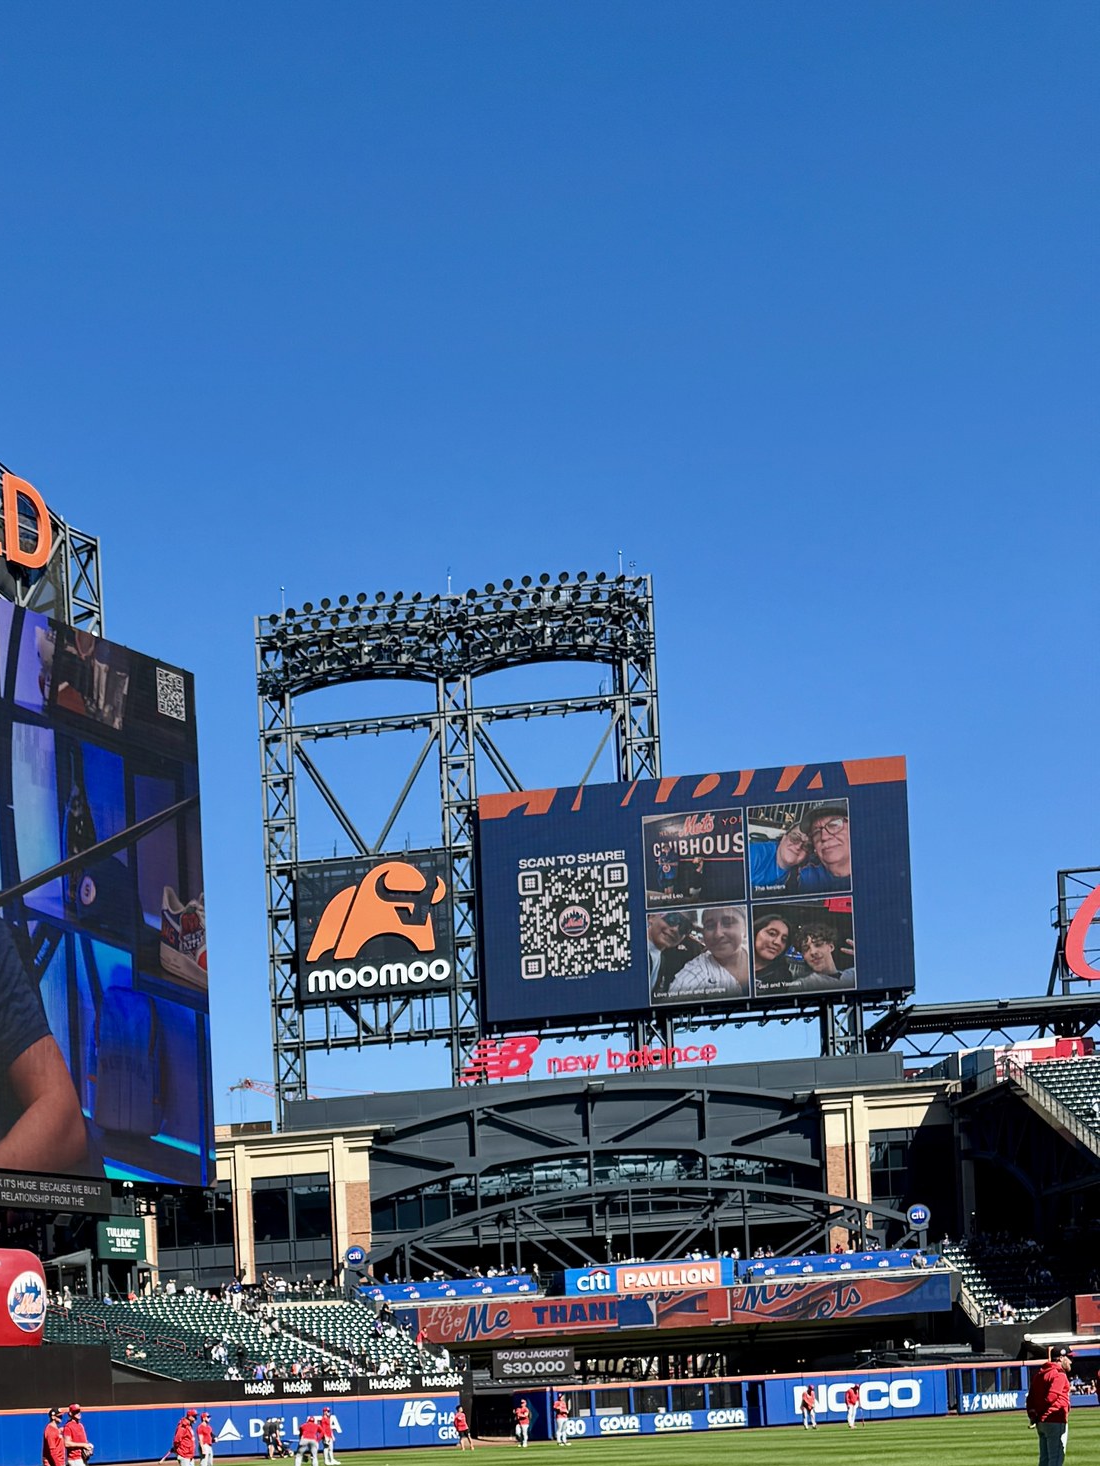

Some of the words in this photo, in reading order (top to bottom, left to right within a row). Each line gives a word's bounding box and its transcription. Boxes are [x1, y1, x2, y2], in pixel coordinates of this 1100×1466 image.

[678, 813, 715, 837] Mets
[653, 832, 744, 857] CUBHOUS
[518, 856, 555, 869] SCAN
[557, 855, 575, 866] TO
[577, 850, 625, 863] SHARE!
[308, 959, 450, 993] moomoo
[547, 1053, 600, 1074] new
[606, 1043, 718, 1069] balance
[3, 1179, 16, 1188] IT'S
[17, 1180, 37, 1190] HUGE
[39, 1182, 71, 1193] BECAUSE
[71, 1184, 83, 1194] WE
[83, 1185, 102, 1196] BUILT
[0, 1191, 50, 1203] RELATIONSHIP
[50, 1195, 71, 1205] FROM
[71, 1196, 85, 1206] THE
[911, 1210, 925, 1220] citi
[576, 1272, 610, 1291] citi
[624, 1266, 715, 1289] PAVILION
[441, 1317, 463, 1335] Go
[456, 1304, 511, 1342] Me
[497, 1351, 526, 1360] 50/50
[527, 1348, 569, 1359] JACKPOT
[503, 1361, 566, 1375] $30,000
[244, 1380, 275, 1396] HubSpot
[283, 1379, 312, 1395] HubSpot
[323, 1378, 351, 1395] HubSpot
[369, 1375, 412, 1391] HubSpot
[421, 1372, 464, 1389] HubSpot
[981, 1391, 1018, 1410] DUNKIN'
[399, 1400, 436, 1427] HG
[438, 1411, 455, 1425] HA
[654, 1412, 691, 1429] GOYA
[707, 1408, 745, 1425] GOYA
[600, 1415, 639, 1432] GOYA
